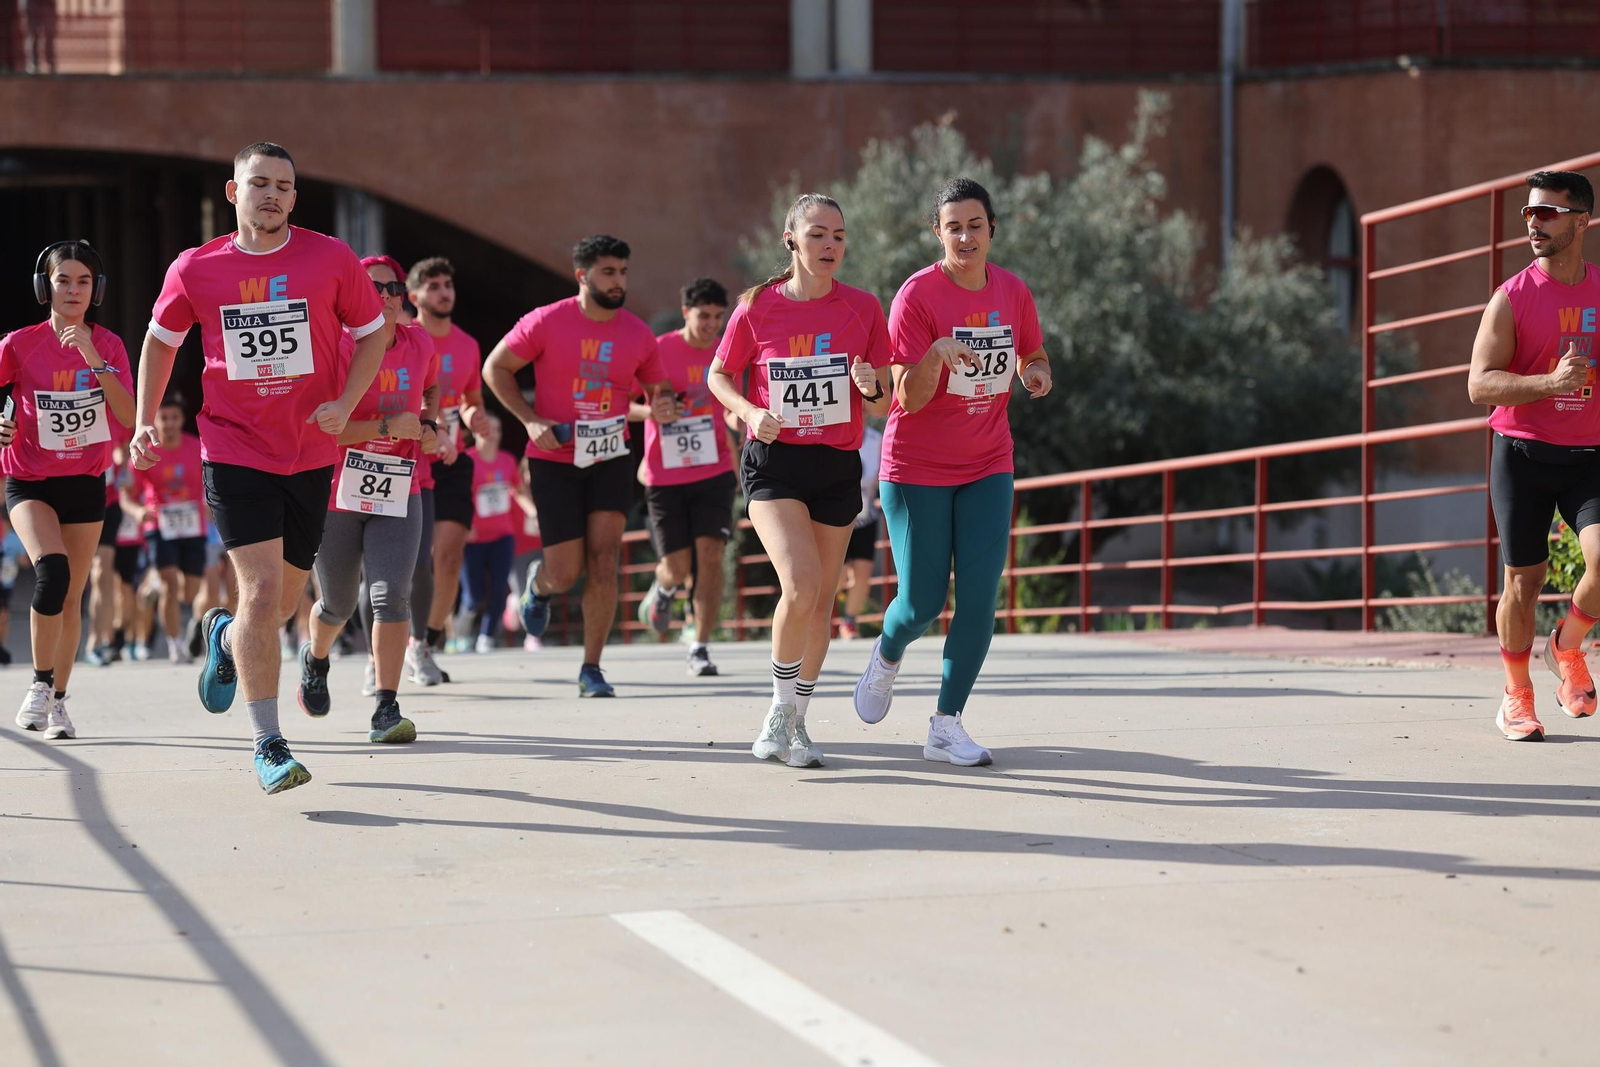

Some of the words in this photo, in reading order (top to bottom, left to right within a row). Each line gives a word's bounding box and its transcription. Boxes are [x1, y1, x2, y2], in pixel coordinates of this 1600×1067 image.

[239, 275, 287, 303] WE
[226, 316, 264, 327] UMA
[965, 311, 1000, 327] WE
[1558, 307, 1596, 332] WE
[239, 327, 298, 358] 395
[581, 339, 613, 362] WE
[789, 333, 831, 357] WE
[53, 369, 90, 392] WE
[379, 368, 410, 392] WE
[772, 370, 807, 379] UMA
[40, 401, 70, 409] UMA
[783, 381, 838, 407] 441
[50, 409, 96, 433] 399
[586, 435, 618, 456] 440
[677, 434, 701, 452] 96
[349, 458, 379, 472] UMA
[360, 474, 392, 498] 84
